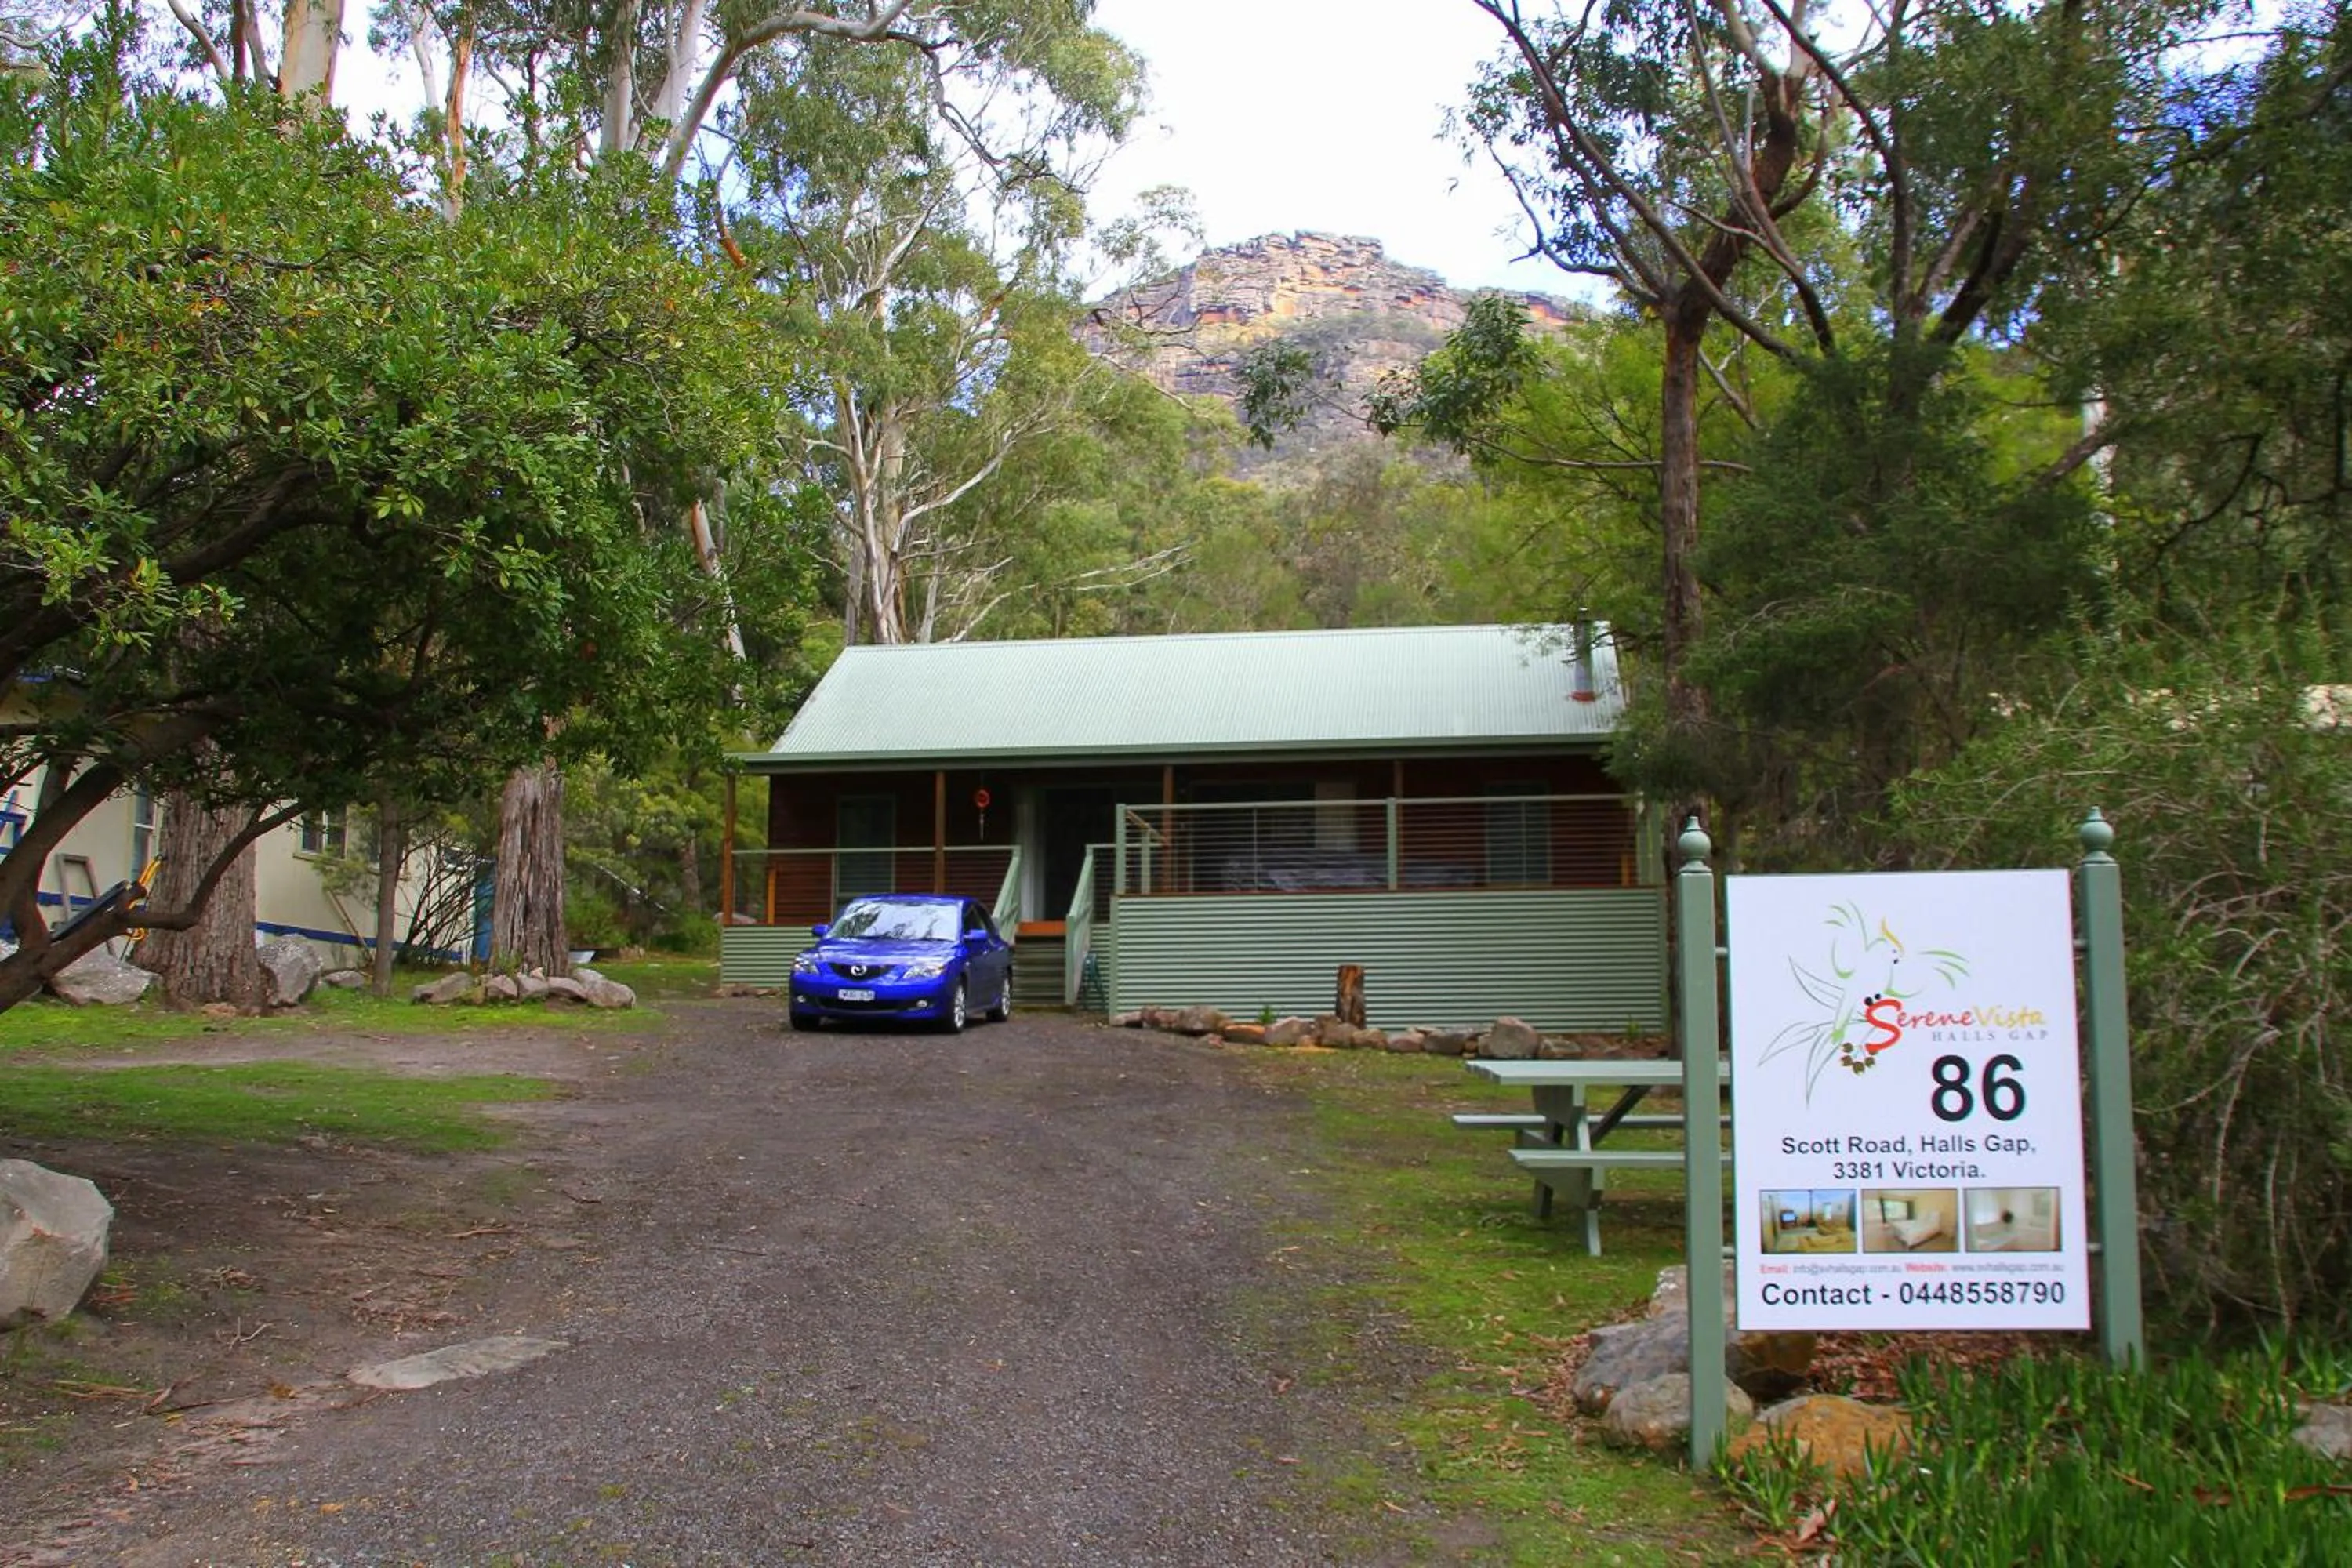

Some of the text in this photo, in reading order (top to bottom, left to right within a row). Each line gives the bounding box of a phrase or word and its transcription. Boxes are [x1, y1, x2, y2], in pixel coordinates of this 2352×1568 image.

[1932, 1029, 2048, 1041] HALLS GAP
[1931, 1054, 2026, 1122] 86
[1782, 1137, 1840, 1154] Scott
[1849, 1136, 1913, 1156] Road,
[1921, 1135, 1976, 1152] Halls
[1834, 1161, 1987, 1179] 3381 Victoria.
[1762, 1283, 1872, 1305] Contact
[1899, 1281, 2065, 1305] 0448558790
